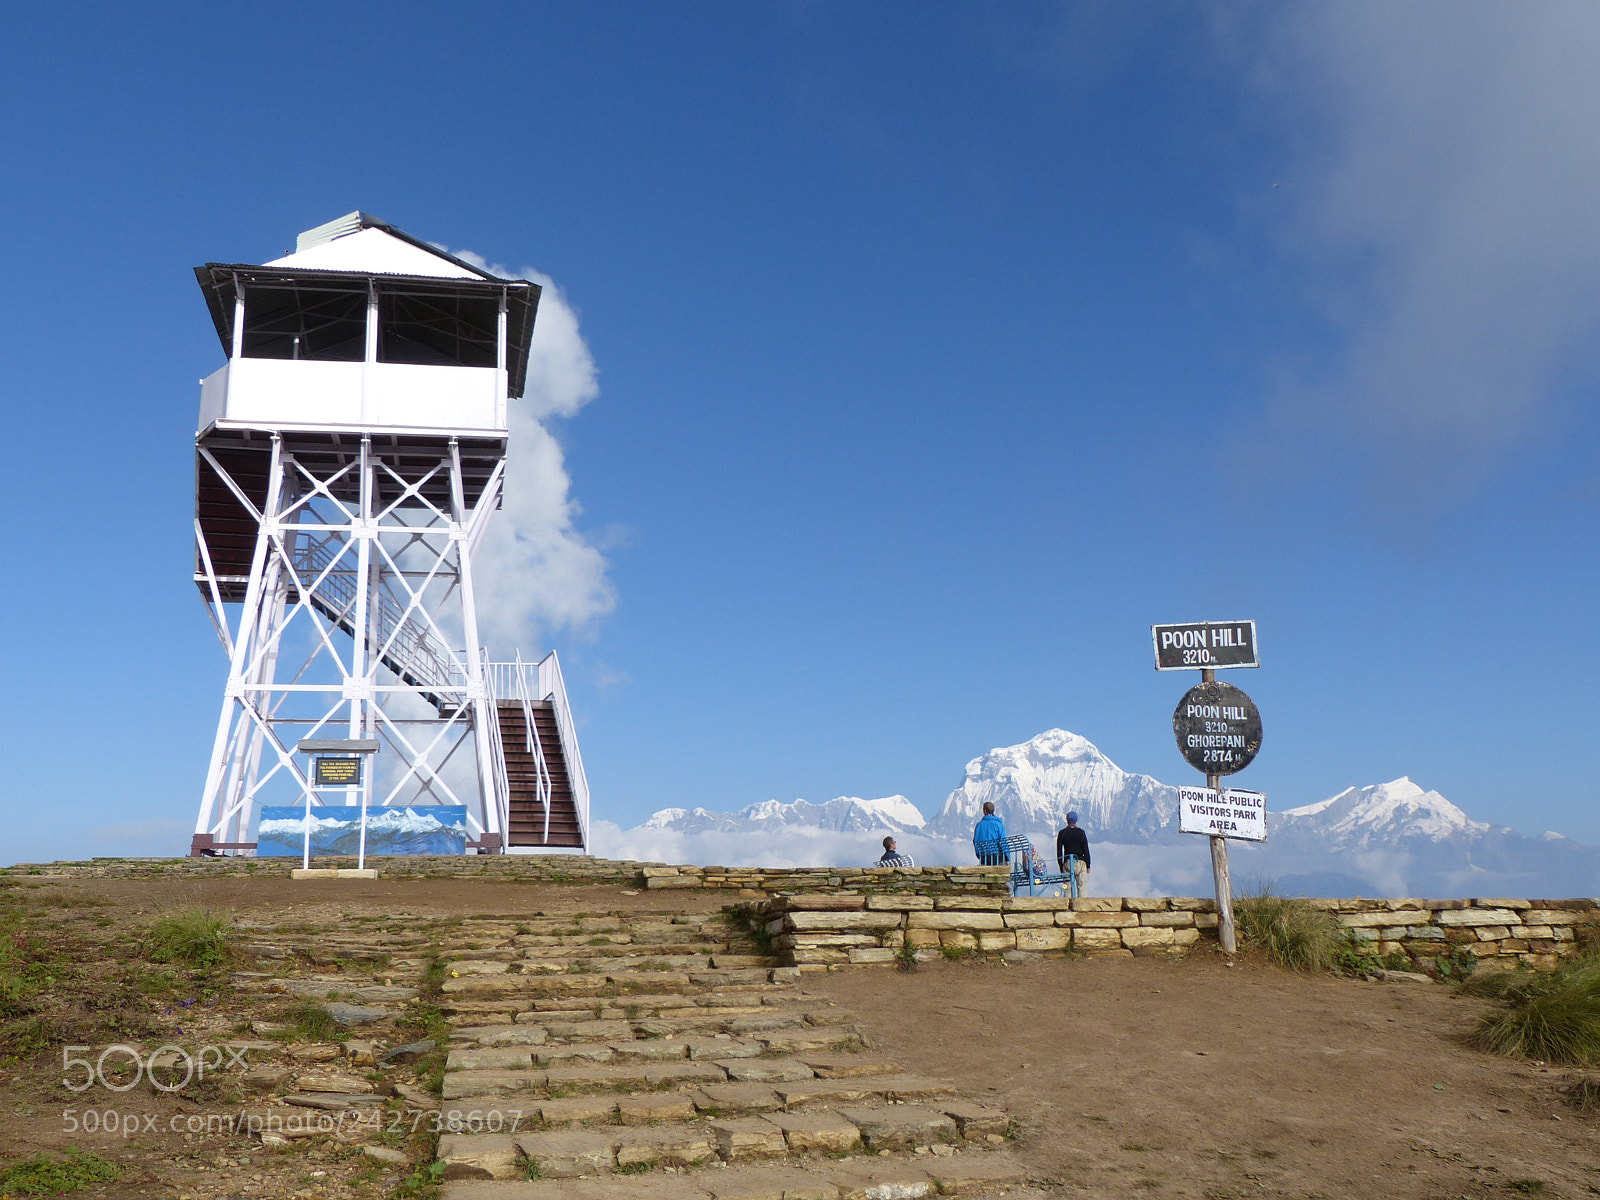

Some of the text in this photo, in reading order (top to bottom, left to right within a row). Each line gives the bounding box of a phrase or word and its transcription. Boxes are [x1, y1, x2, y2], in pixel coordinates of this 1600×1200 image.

[1161, 627, 1247, 650] POON HILL
[1182, 649, 1210, 664] 3210
[1187, 704, 1248, 720] POON HILL
[1205, 721, 1228, 733] 3210
[1187, 734, 1246, 748] GHOREPANI
[1203, 750, 1233, 762] 2874
[1181, 790, 1262, 808] POON HILL PUBLIC
[1190, 804, 1257, 820] VISITORS PARK
[1209, 819, 1237, 831] AREA
